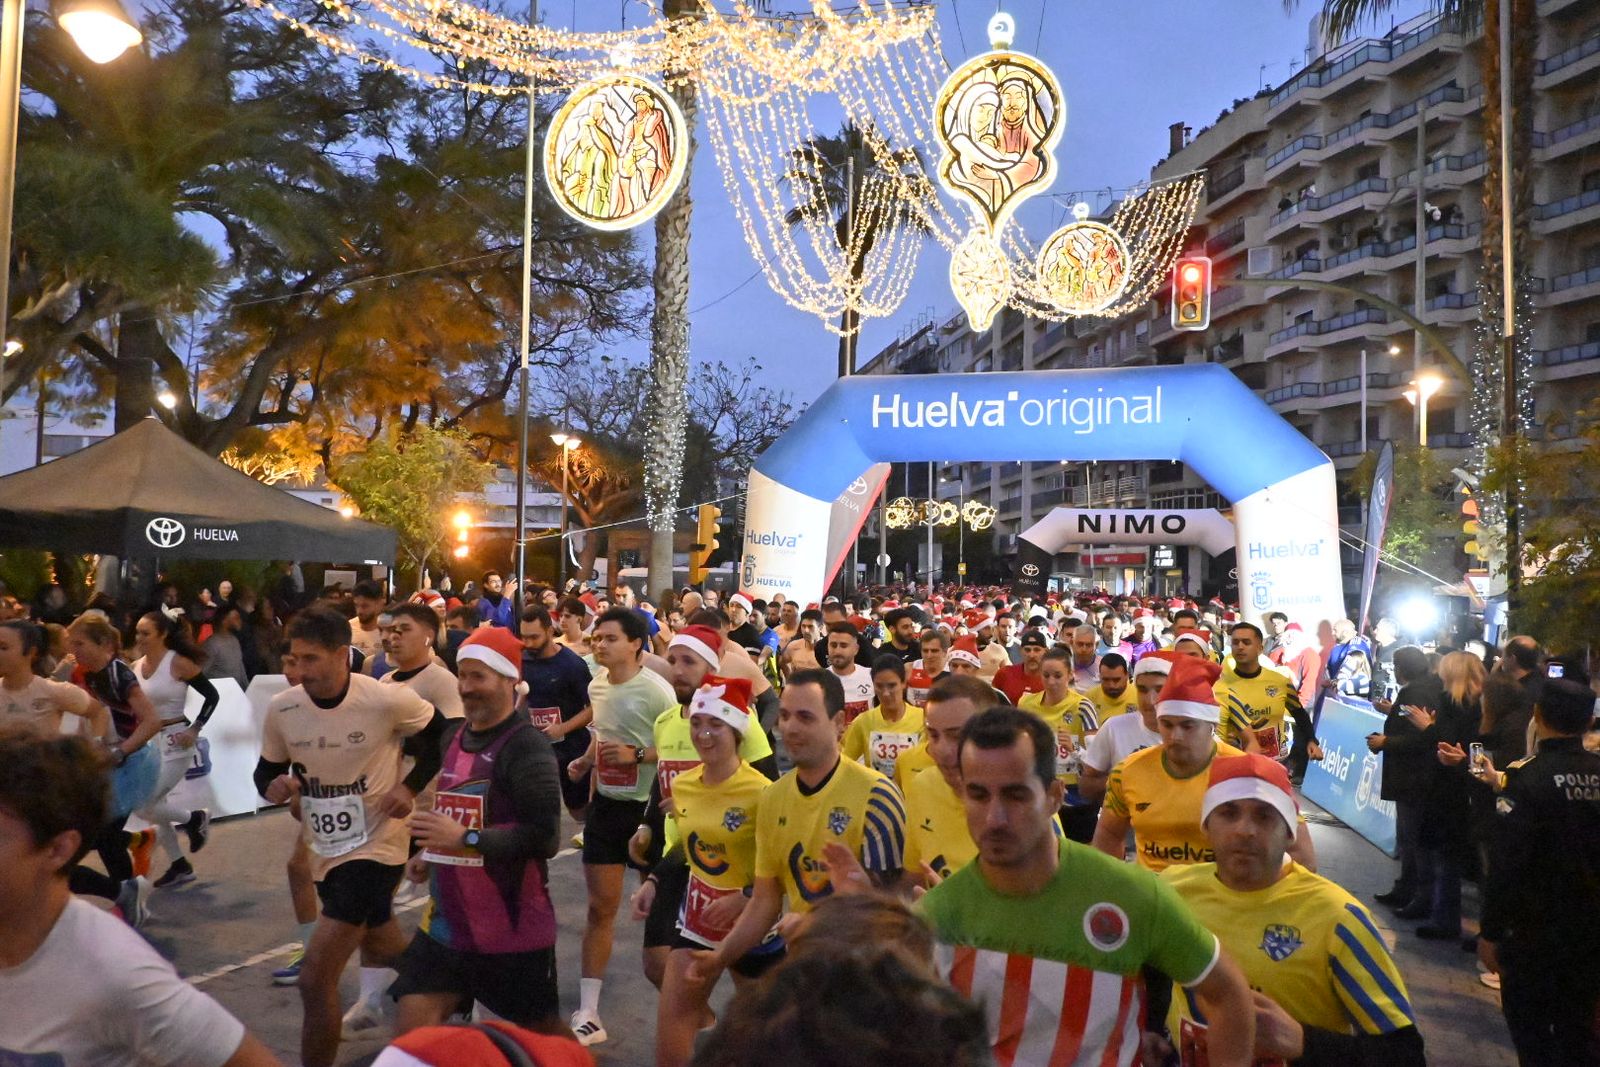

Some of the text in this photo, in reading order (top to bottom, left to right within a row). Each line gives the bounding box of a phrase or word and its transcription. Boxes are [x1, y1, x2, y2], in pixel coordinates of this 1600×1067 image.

[872, 386, 1161, 434] Huelva original
[1077, 514, 1186, 534] NIMO
[193, 528, 239, 541] HUELVA
[746, 529, 797, 548] Huelva
[1248, 541, 1320, 560] Huelva
[756, 577, 792, 588] HUELVA
[1249, 706, 1271, 717] Snell
[877, 743, 910, 760] 33
[310, 811, 352, 834] 389
[1144, 842, 1217, 863] Huelva
